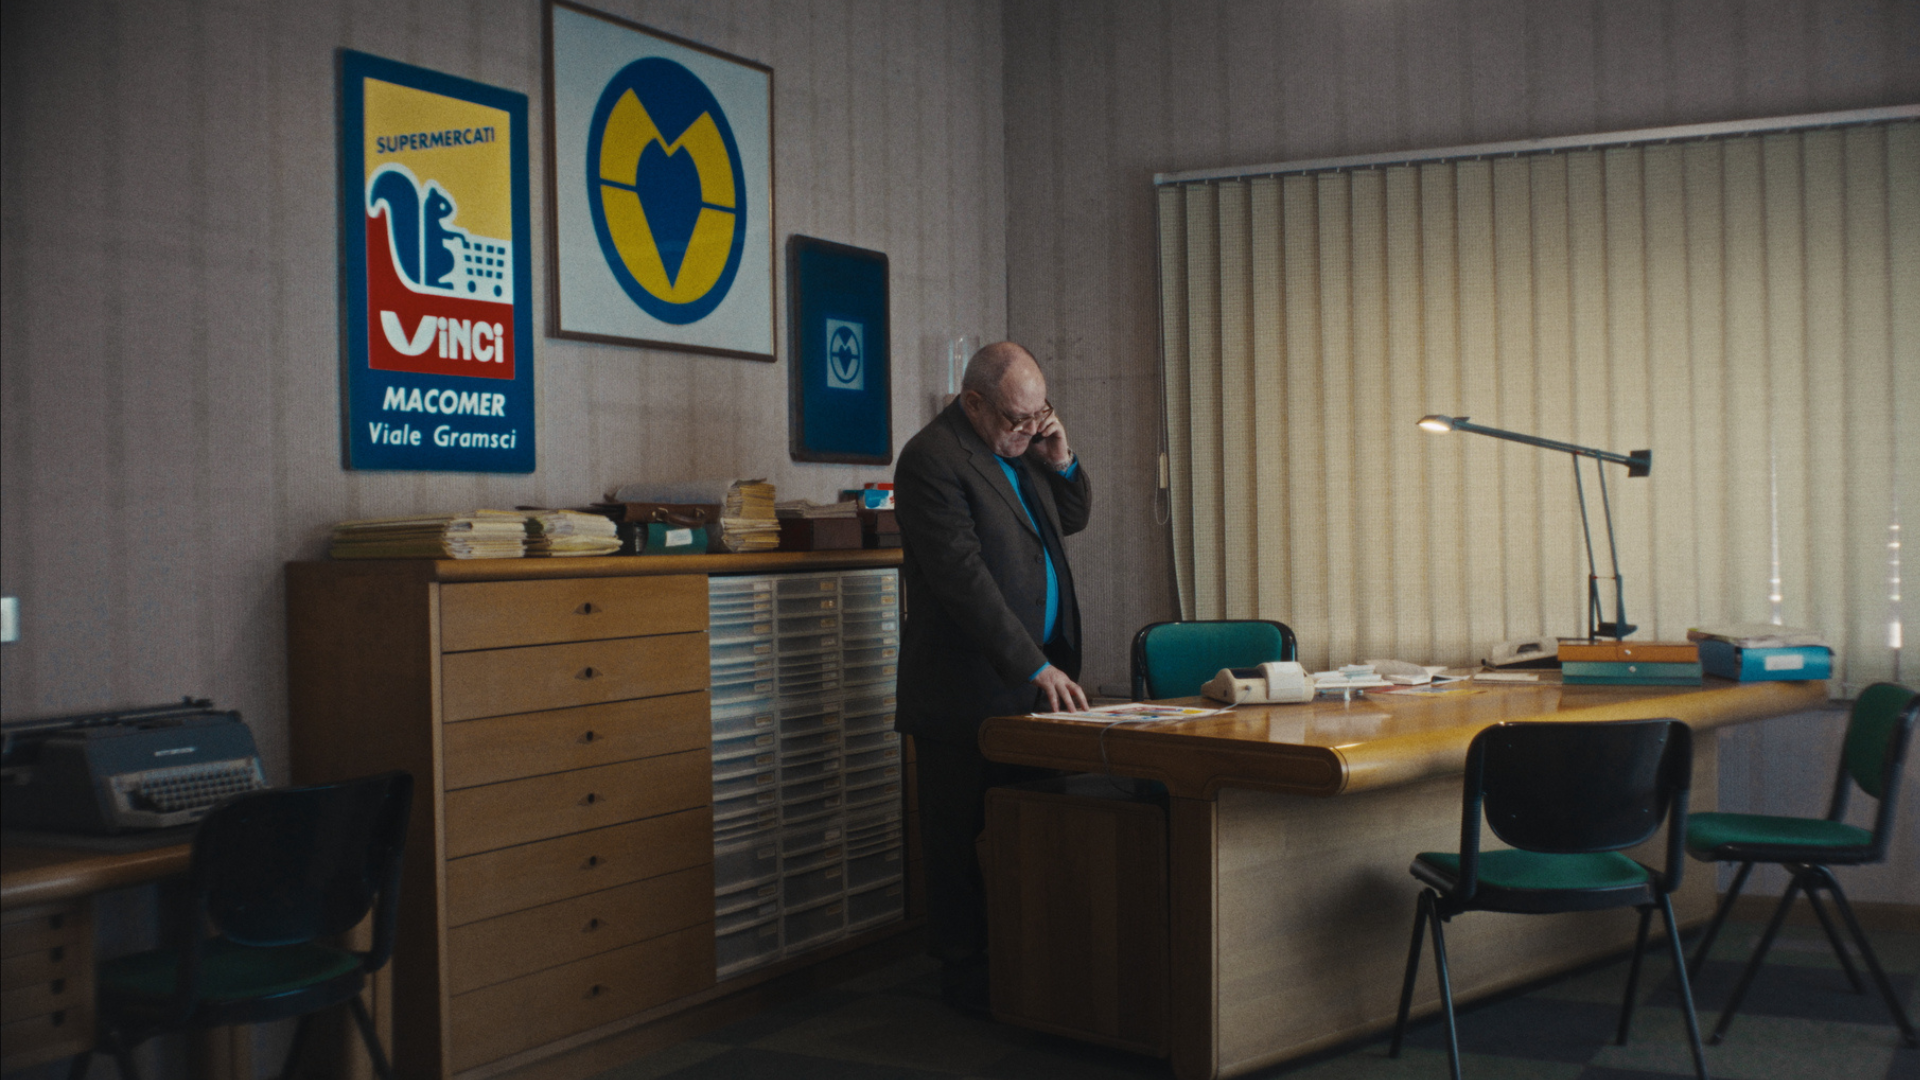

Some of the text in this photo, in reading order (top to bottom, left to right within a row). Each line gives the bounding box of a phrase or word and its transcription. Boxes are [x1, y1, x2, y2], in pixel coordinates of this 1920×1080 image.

[376, 126, 495, 154] SUPERMERCATI
[382, 386, 506, 417] MACOMER
[368, 421, 517, 449] Viale Gramsci
